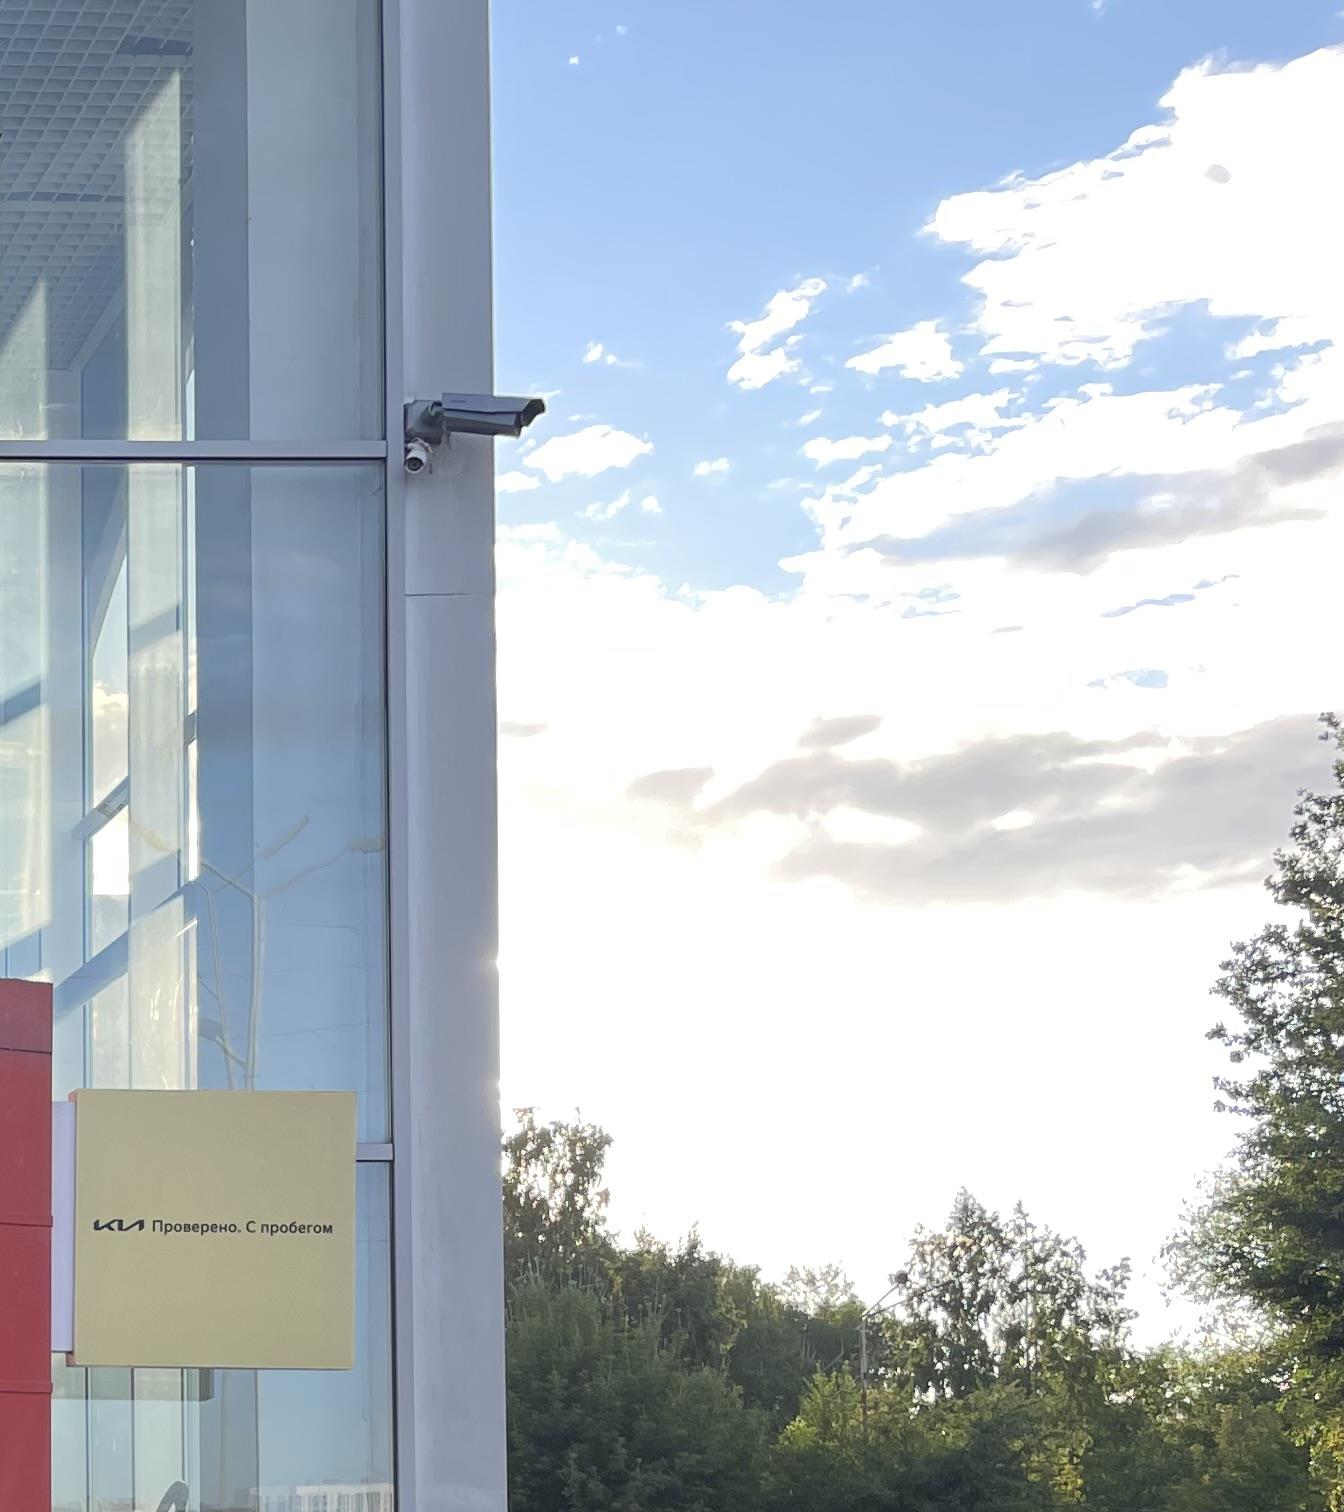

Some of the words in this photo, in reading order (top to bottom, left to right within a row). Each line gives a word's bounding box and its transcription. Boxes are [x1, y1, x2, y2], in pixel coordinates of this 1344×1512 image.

[152, 1219, 242, 1236] Проверено.
[246, 1220, 256, 1234] С
[261, 1220, 333, 1235] пробегом
